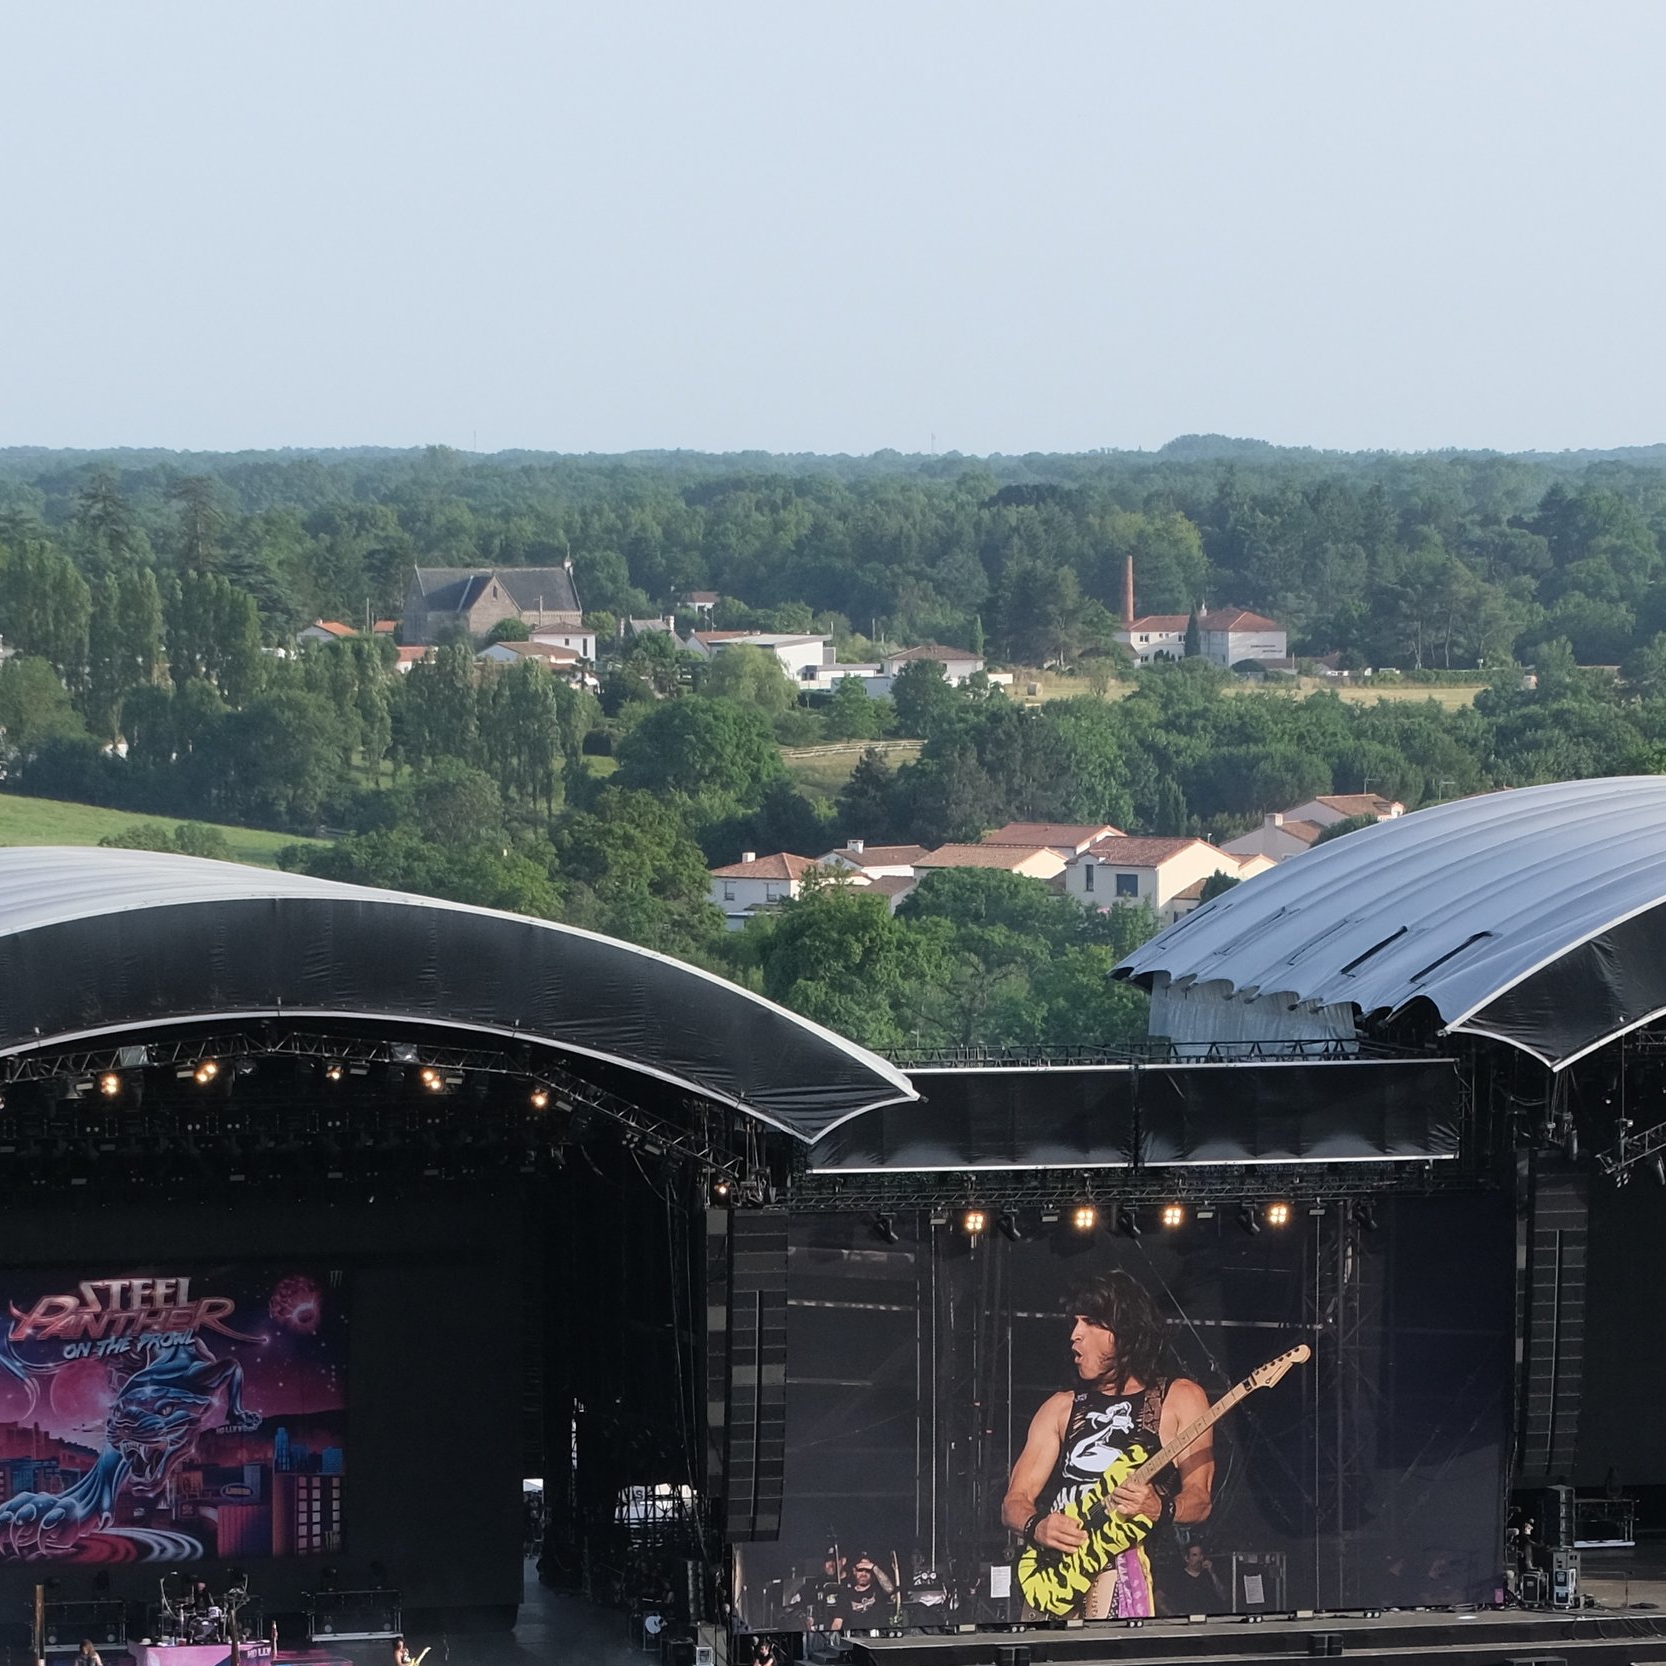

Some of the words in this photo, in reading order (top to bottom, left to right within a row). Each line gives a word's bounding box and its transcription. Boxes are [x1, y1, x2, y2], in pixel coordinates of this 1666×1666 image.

[79, 1277, 192, 1312] STEEL
[9, 1296, 267, 1343] PANTHER
[63, 1341, 88, 1360] ON
[92, 1334, 131, 1357] THE
[136, 1328, 195, 1351] PROWL
